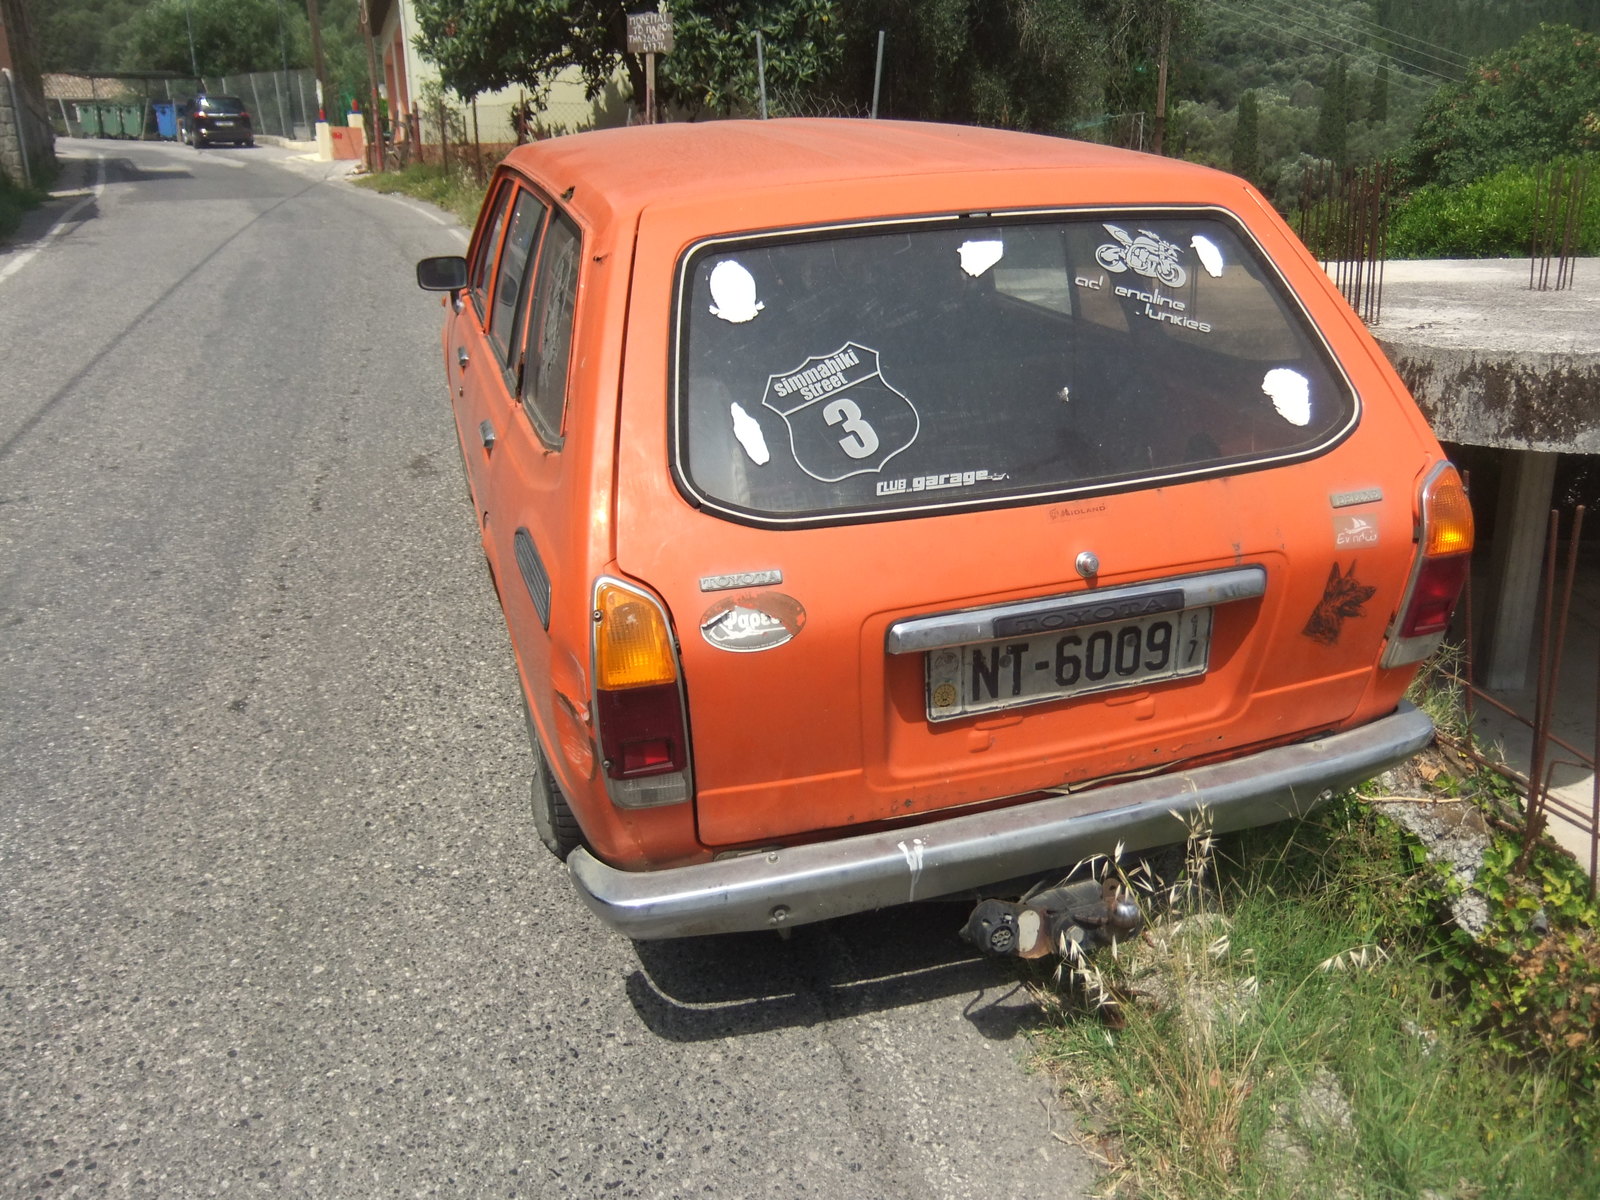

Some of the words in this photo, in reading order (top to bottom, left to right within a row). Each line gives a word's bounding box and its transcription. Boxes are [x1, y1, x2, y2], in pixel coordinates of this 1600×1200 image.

[773, 349, 860, 398] simmahiki
[800, 371, 848, 401] street
[822, 398, 880, 459] 3
[876, 478, 907, 496] CLUB
[912, 469, 989, 492] garage
[702, 573, 779, 590] TOYOTA
[1016, 599, 1166, 633] TOYOTA
[971, 620, 1174, 701] NT-6009
